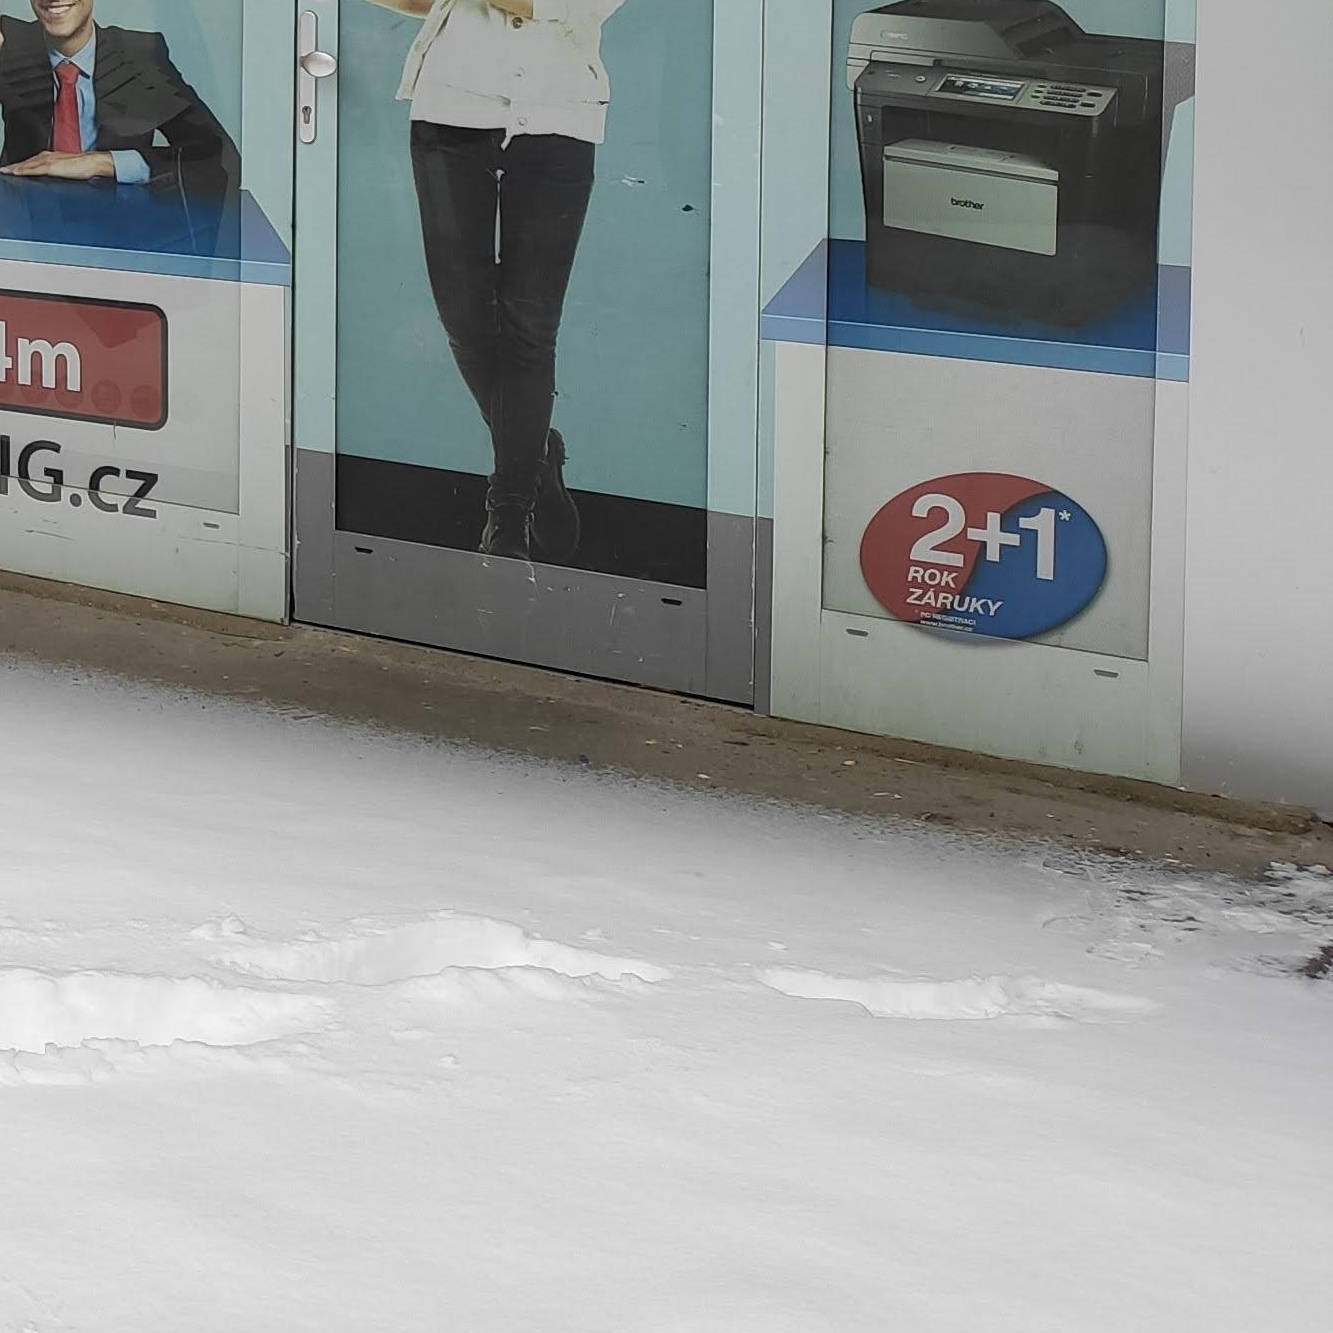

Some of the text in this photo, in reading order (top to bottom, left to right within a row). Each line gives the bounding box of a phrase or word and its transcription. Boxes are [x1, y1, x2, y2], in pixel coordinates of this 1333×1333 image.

[950, 197, 985, 211] brother
[906, 566, 959, 588] ROK
[905, 587, 1004, 617] ZÁRUKY
